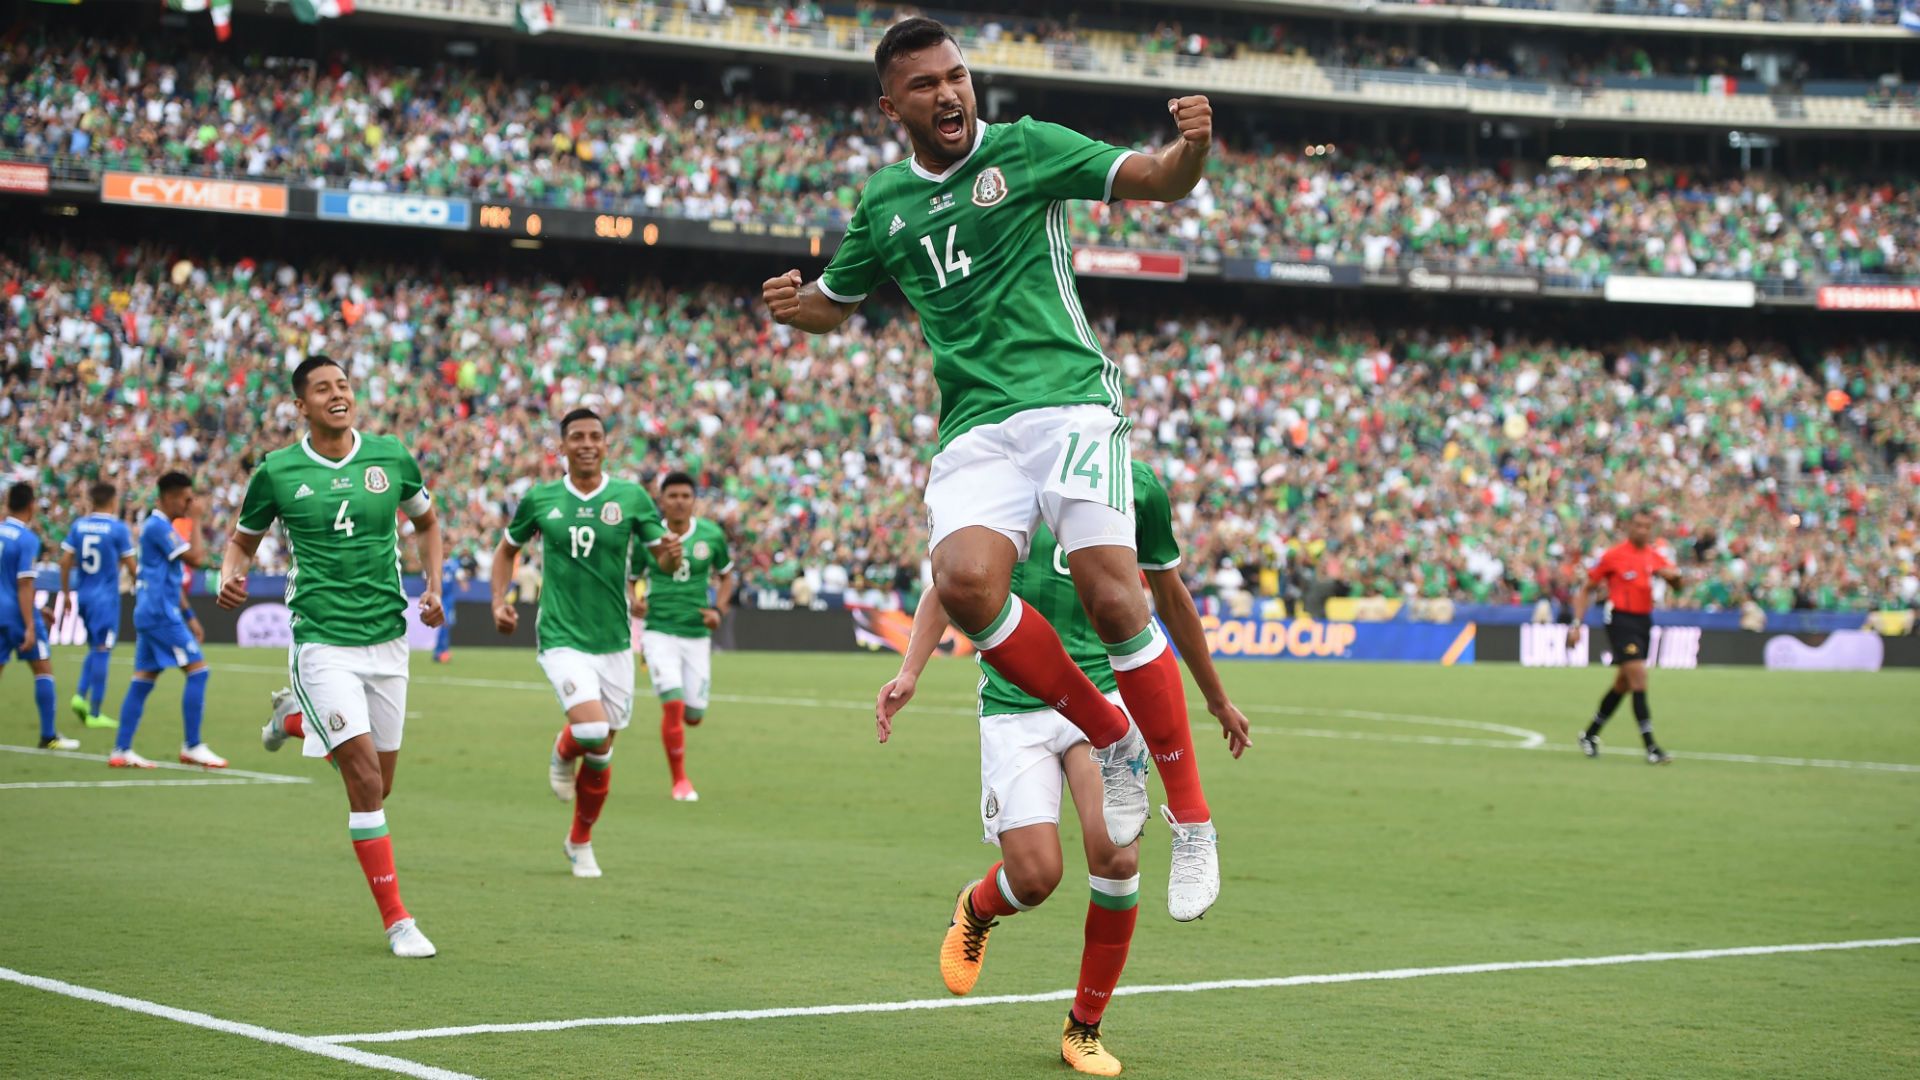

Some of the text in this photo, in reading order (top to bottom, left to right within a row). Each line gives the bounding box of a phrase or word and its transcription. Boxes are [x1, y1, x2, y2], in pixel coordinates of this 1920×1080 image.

[129, 177, 262, 211] CYMER
[347, 193, 449, 225] GEICO
[526, 213, 542, 236] 0
[643, 223, 659, 246] 0
[919, 224, 973, 288] 14
[1060, 432, 1103, 489] 14
[333, 500, 355, 537] 4
[81, 534, 101, 574] 5
[568, 525, 596, 558] 19
[1199, 614, 1356, 656] GOLD CUP
[1155, 748, 1184, 763] FMF
[373, 873, 395, 885] FMF
[1084, 986, 1110, 999] FMF
